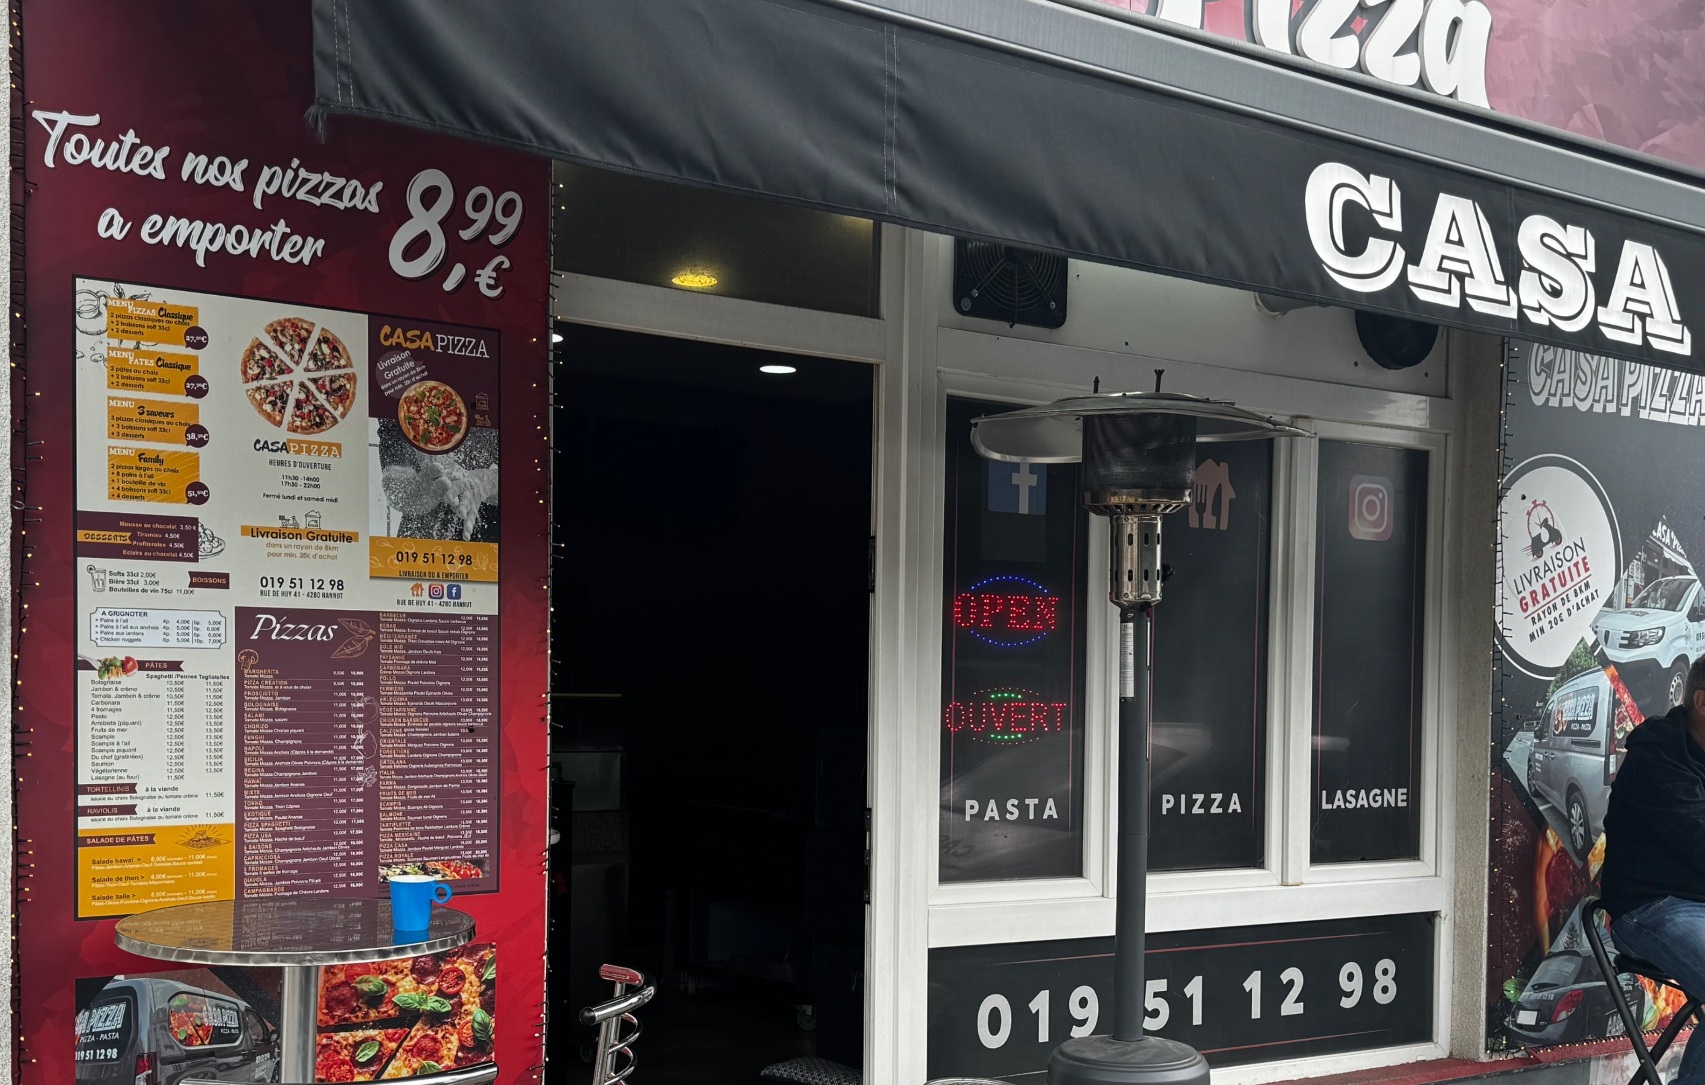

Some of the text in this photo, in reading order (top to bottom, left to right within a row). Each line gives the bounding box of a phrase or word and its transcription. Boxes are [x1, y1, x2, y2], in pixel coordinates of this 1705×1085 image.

[31, 110, 384, 214] Toutes nos pizzas
[140, 212, 325, 268] emporter
[1304, 161, 1693, 356] CASA
[128, 306, 193, 322] PIZZAS Classique
[135, 315, 164, 323] classiques
[380, 325, 490, 358] CASA PIZZA
[109, 351, 134, 359] MENU
[377, 350, 411, 370] Livraison
[156, 357, 191, 371] Classique
[384, 360, 415, 380] Gratuite
[1528, 343, 1618, 413] CASA
[109, 400, 135, 408] MENU
[137, 406, 174, 418] 3 saveurs
[109, 448, 135, 456] MENU
[253, 438, 341, 458] CASA PIZZA
[138, 453, 164, 466] Family
[269, 459, 332, 471] HEURES D'OUVERTURE
[263, 492, 281, 500] Fermé
[304, 495, 325, 503] samedi
[152, 522, 177, 530] chocolat
[84, 533, 128, 542] DESSERTS
[251, 527, 353, 544] Livraison Gratuite
[267, 551, 283, 559] pour
[284, 551, 299, 559] min.
[312, 553, 338, 561] d'achat
[294, 544, 313, 552] rayon
[396, 551, 472, 566] 019 51 12 98
[1513, 536, 1586, 595] LIVRAISON
[399, 570, 427, 578] LIVRAISON
[260, 576, 345, 591] 019 51 12 98
[1519, 555, 1590, 614] GRATUITE
[260, 589, 271, 597] RUE
[306, 591, 321, 599] 4280
[954, 593, 1059, 630] OPEN
[1531, 581, 1591, 626] RAYON DE 8KM
[1529, 590, 1600, 643] MIN 20€ D'ACHAT
[945, 701, 1067, 732] OUVERT
[1161, 793, 1242, 815] PIZZA
[1321, 788, 1408, 810] LASAGNE
[965, 798, 1058, 821] PASTA
[977, 958, 1397, 1049] 019 51 12 98
[90, 1002, 126, 1032] PIZZA
[100, 1032, 119, 1040] PASTA
[85, 1050, 93, 1060] 51
[96, 1049, 105, 1060] 12
[106, 1048, 118, 1059] 98
